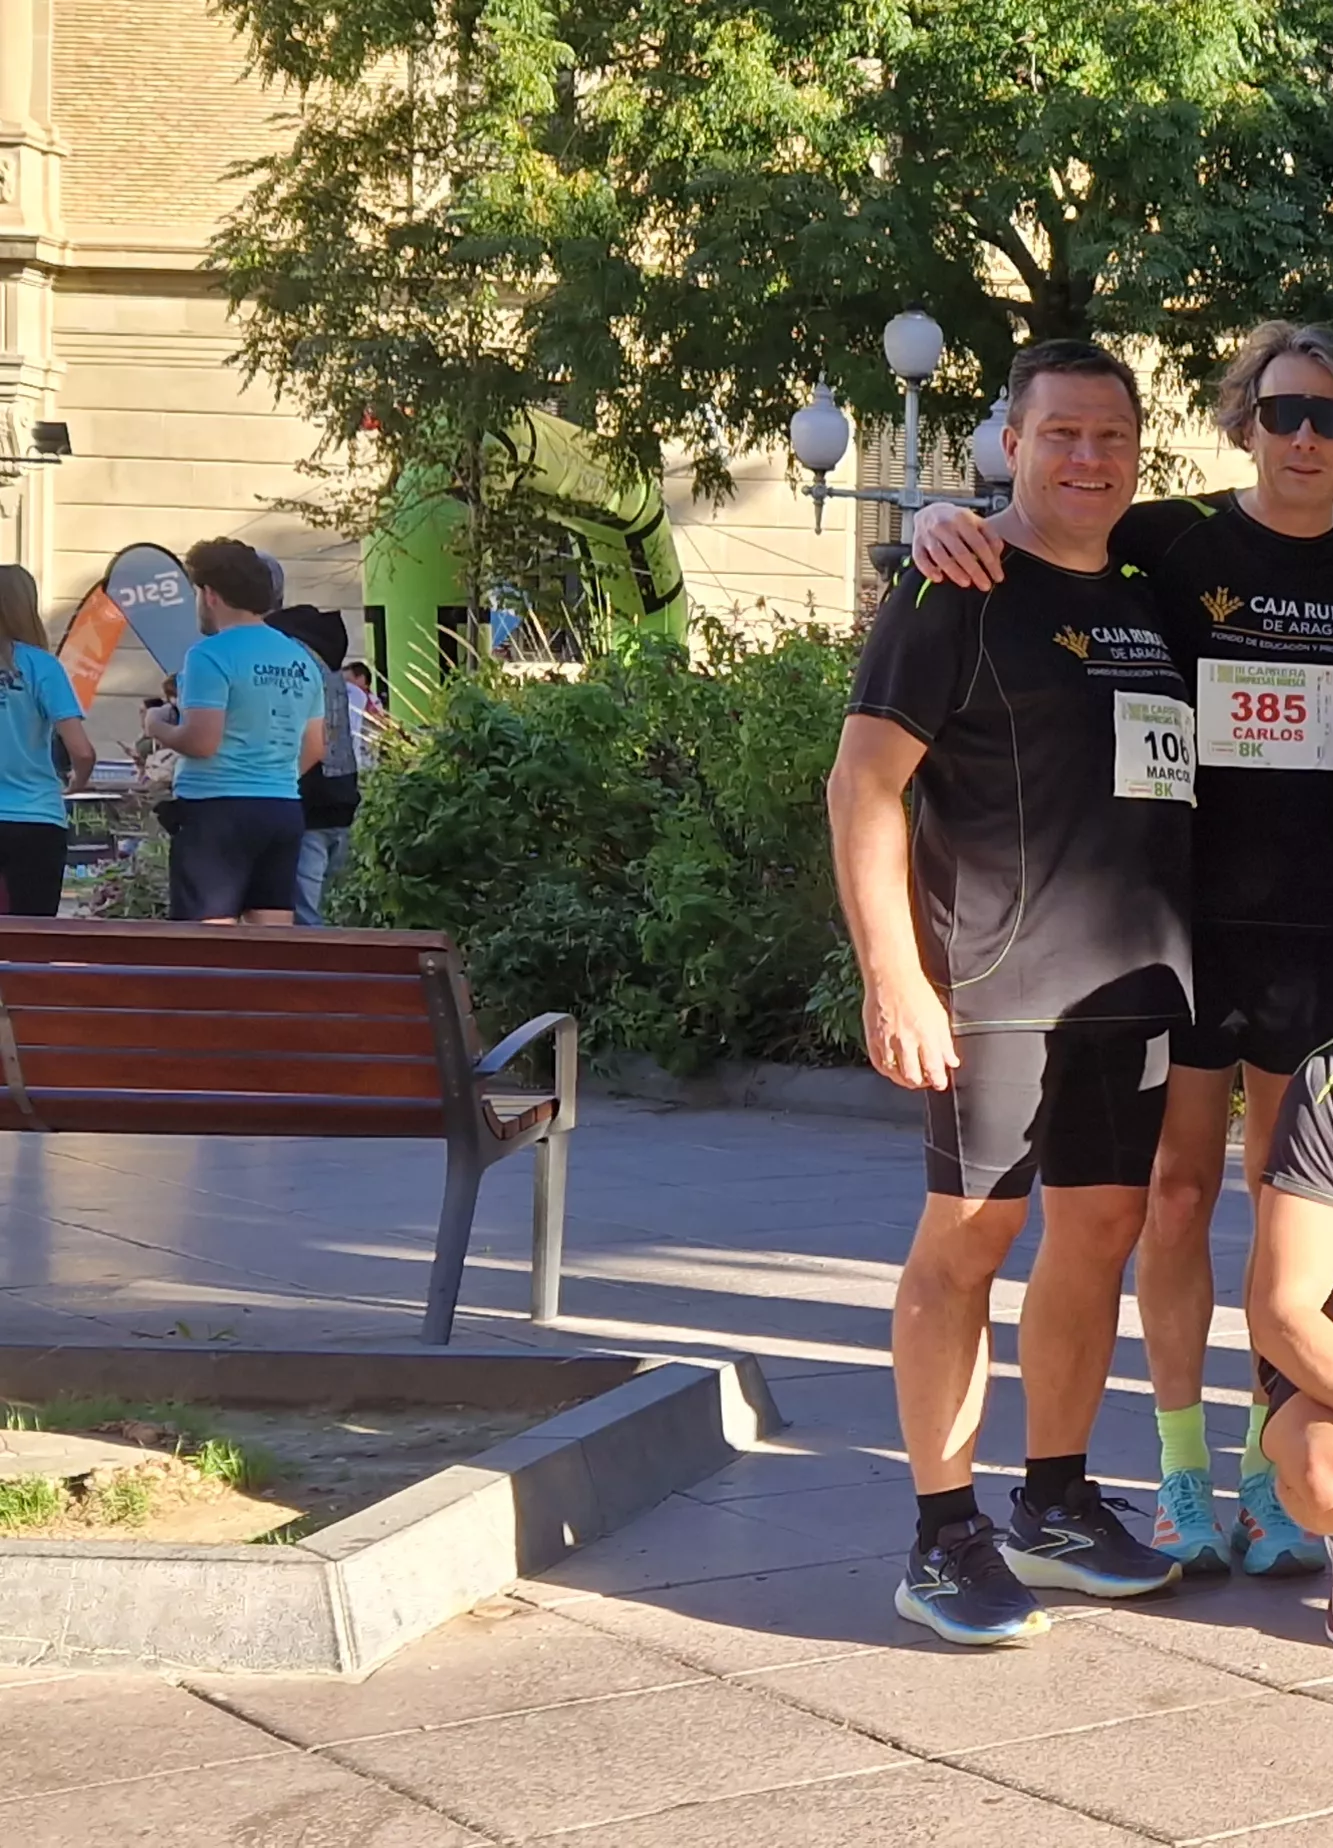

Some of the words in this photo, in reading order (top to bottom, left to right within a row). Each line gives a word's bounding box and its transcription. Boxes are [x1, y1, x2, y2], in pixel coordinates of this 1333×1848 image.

[1250, 596, 1300, 617] CAJA
[1263, 618, 1284, 632] DE
[1091, 627, 1131, 643] CAJA
[1110, 647, 1128, 659] DE
[1248, 666, 1306, 678] CARRERA
[1231, 692, 1307, 724] 385
[1233, 727, 1304, 742] CARLOS
[1144, 731, 1189, 766] 106
[1239, 742, 1263, 757] 8K
[1154, 782, 1173, 797] 8K
